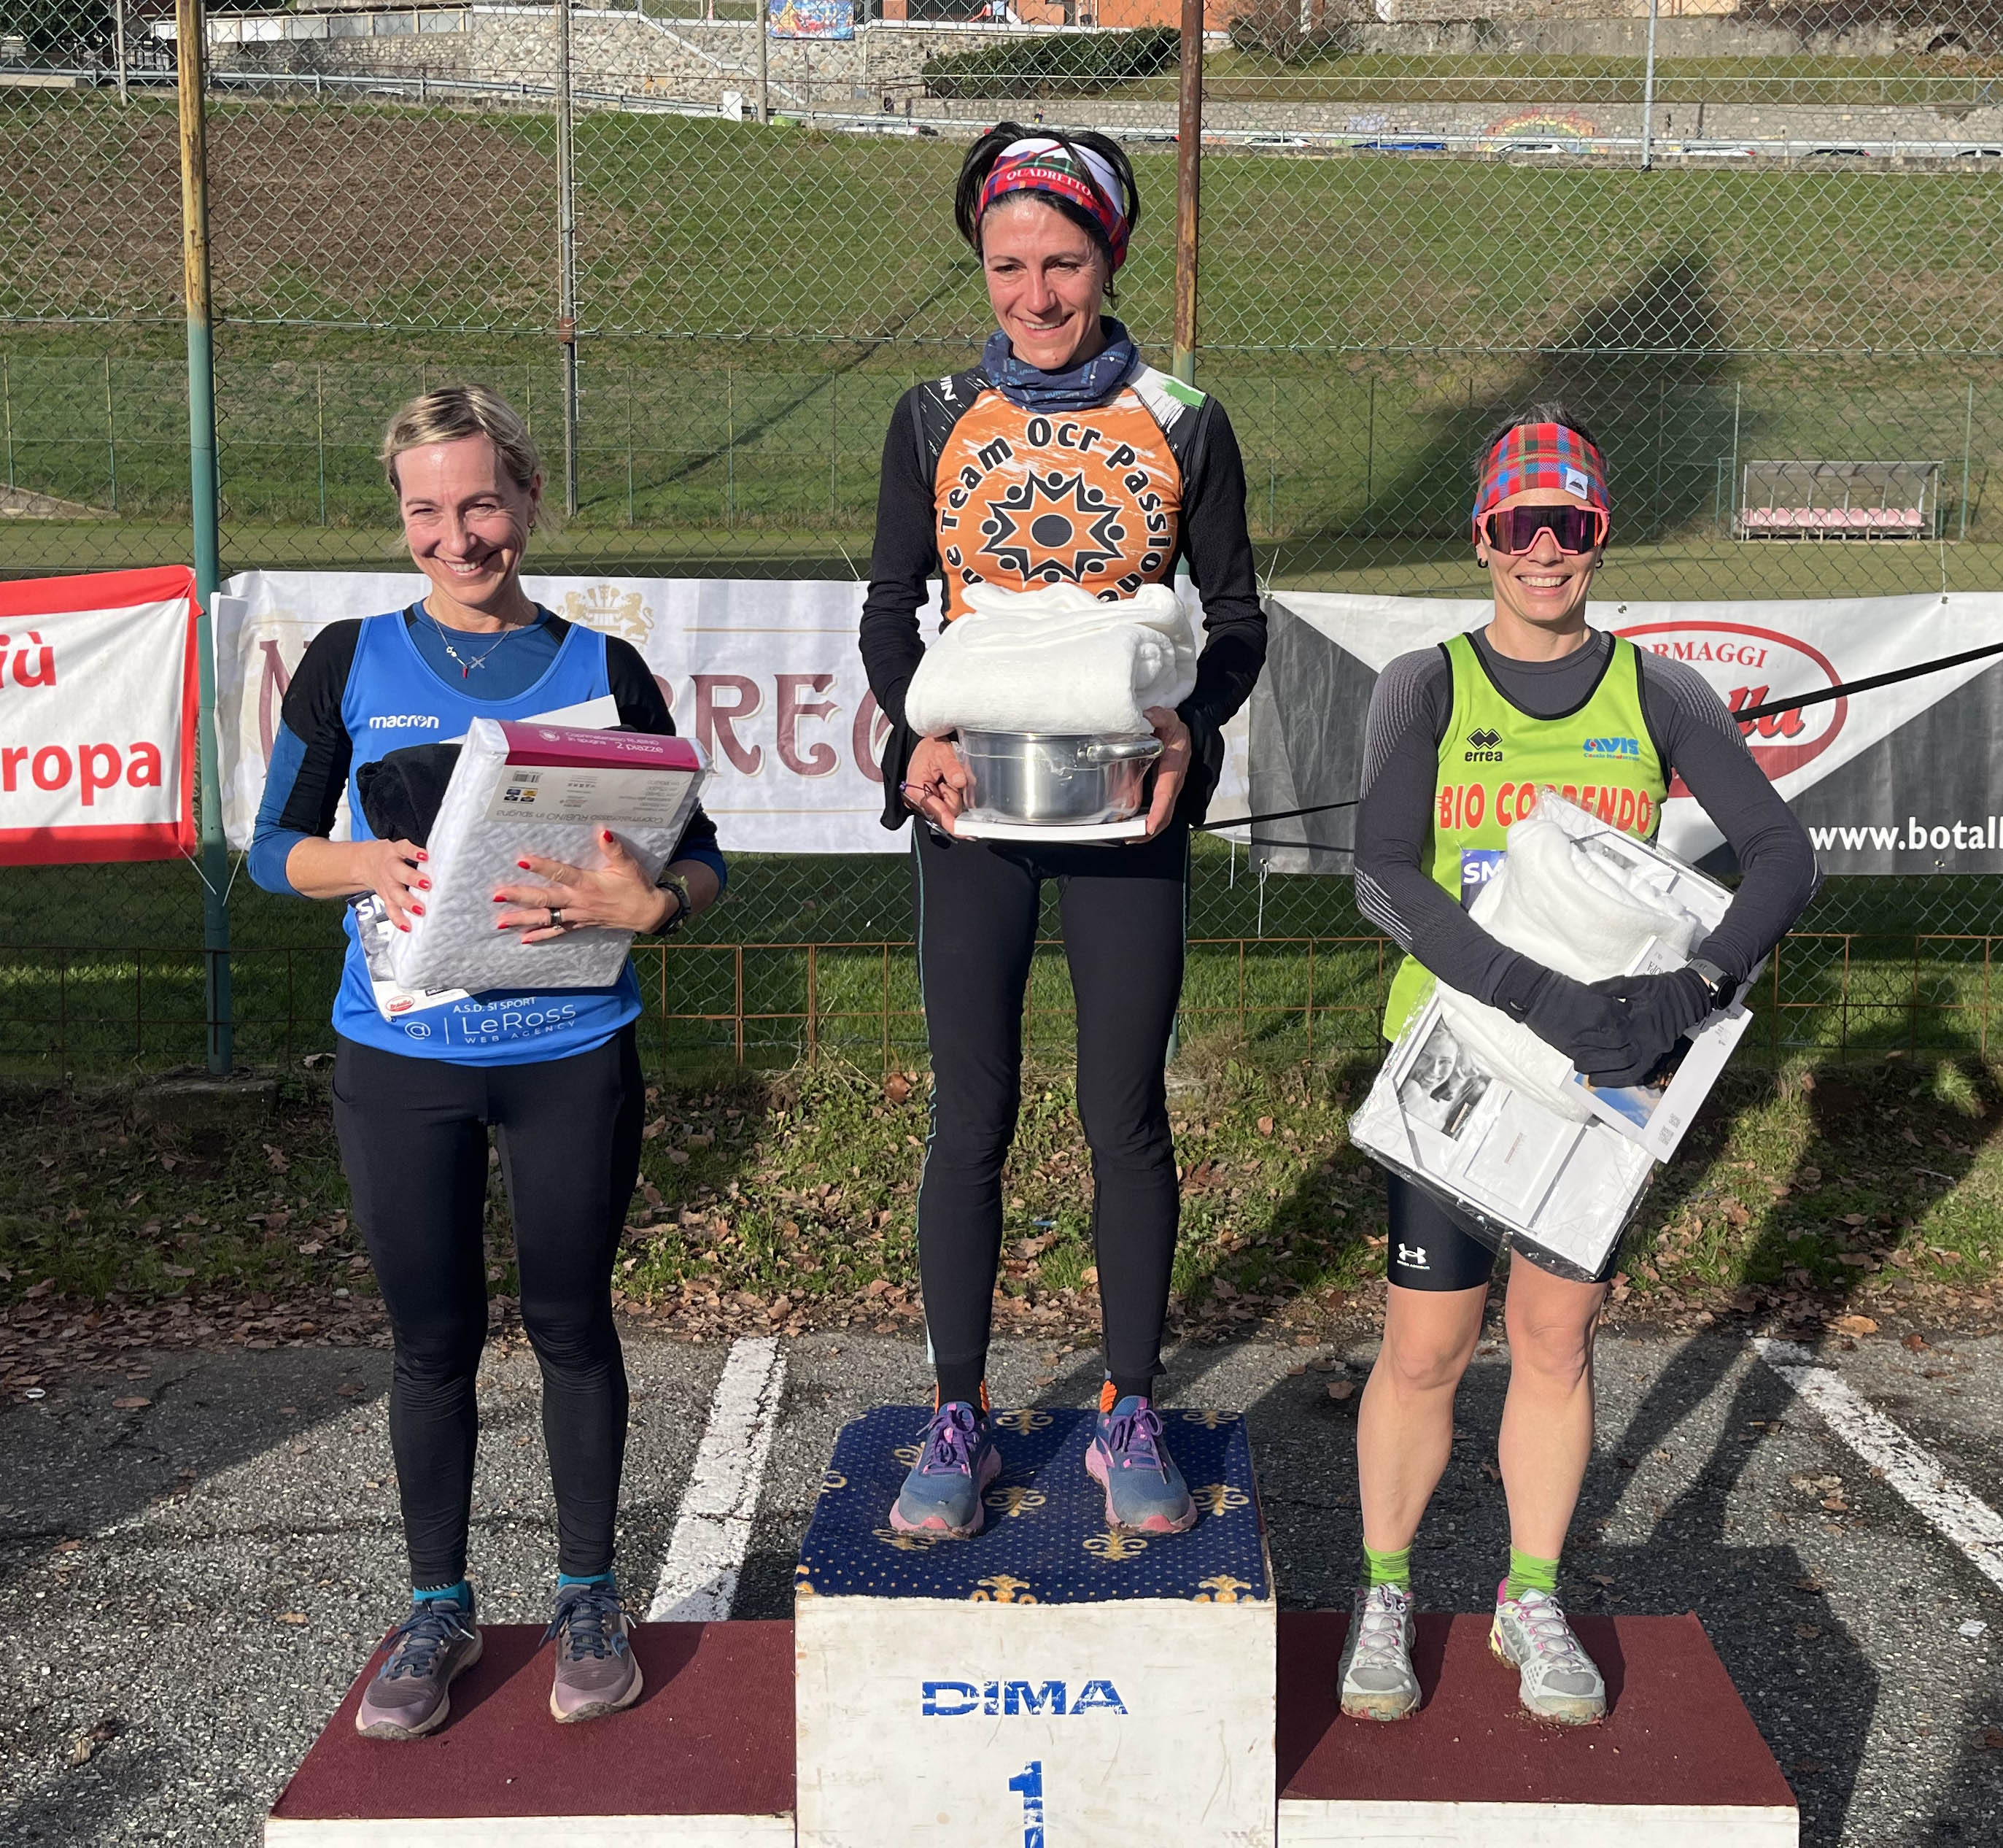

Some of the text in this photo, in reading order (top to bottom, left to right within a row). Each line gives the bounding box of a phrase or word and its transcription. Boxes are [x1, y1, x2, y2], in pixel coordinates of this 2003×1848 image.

[940, 437, 1015, 534] Team
[1026, 417, 1101, 452] Ocr
[1639, 641, 1769, 668] RMAGGI
[368, 714, 440, 730] macron
[1464, 751, 1503, 762] errea
[1583, 737, 1640, 755] AVIS
[1436, 782, 1653, 835] BIO COENDO
[453, 1003, 486, 1013] A.S.D.
[500, 996, 537, 1010] SPORT
[462, 1004, 577, 1035] LeRoss
[464, 1020, 576, 1044] WEB AGENCY
[921, 1679, 1129, 1716] DIMA
[1008, 1760, 1045, 1848] 1
